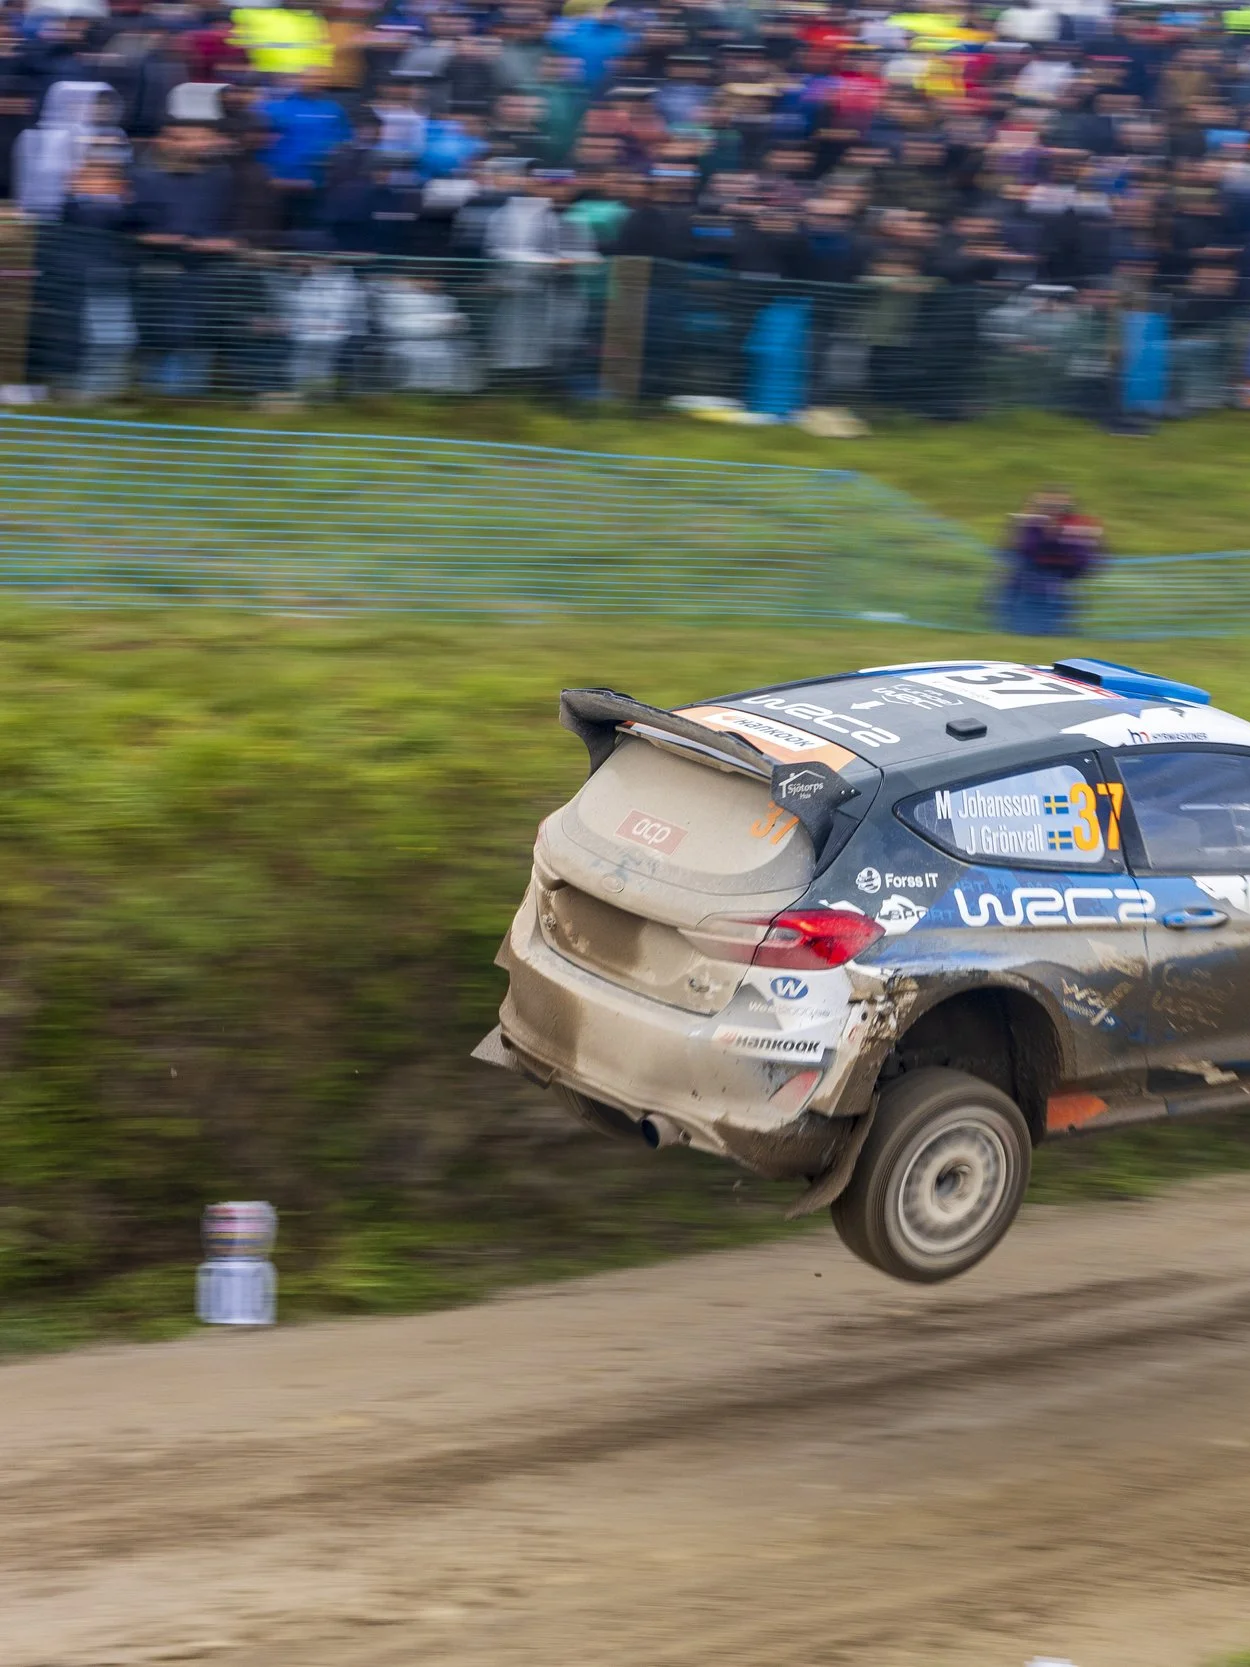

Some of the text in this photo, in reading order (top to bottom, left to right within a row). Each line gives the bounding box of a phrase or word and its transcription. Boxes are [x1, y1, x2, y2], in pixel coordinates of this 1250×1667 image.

[945, 671, 1086, 696] 37
[742, 694, 901, 748] WRC2
[787, 782, 824, 796] Sjötorps
[935, 790, 1041, 820] M Johansson
[1069, 782, 1124, 851] 37
[965, 824, 1045, 855] J Grönvall
[885, 873, 923, 888] Forss
[924, 873, 939, 888] IT
[953, 887, 1157, 927] WRC2
